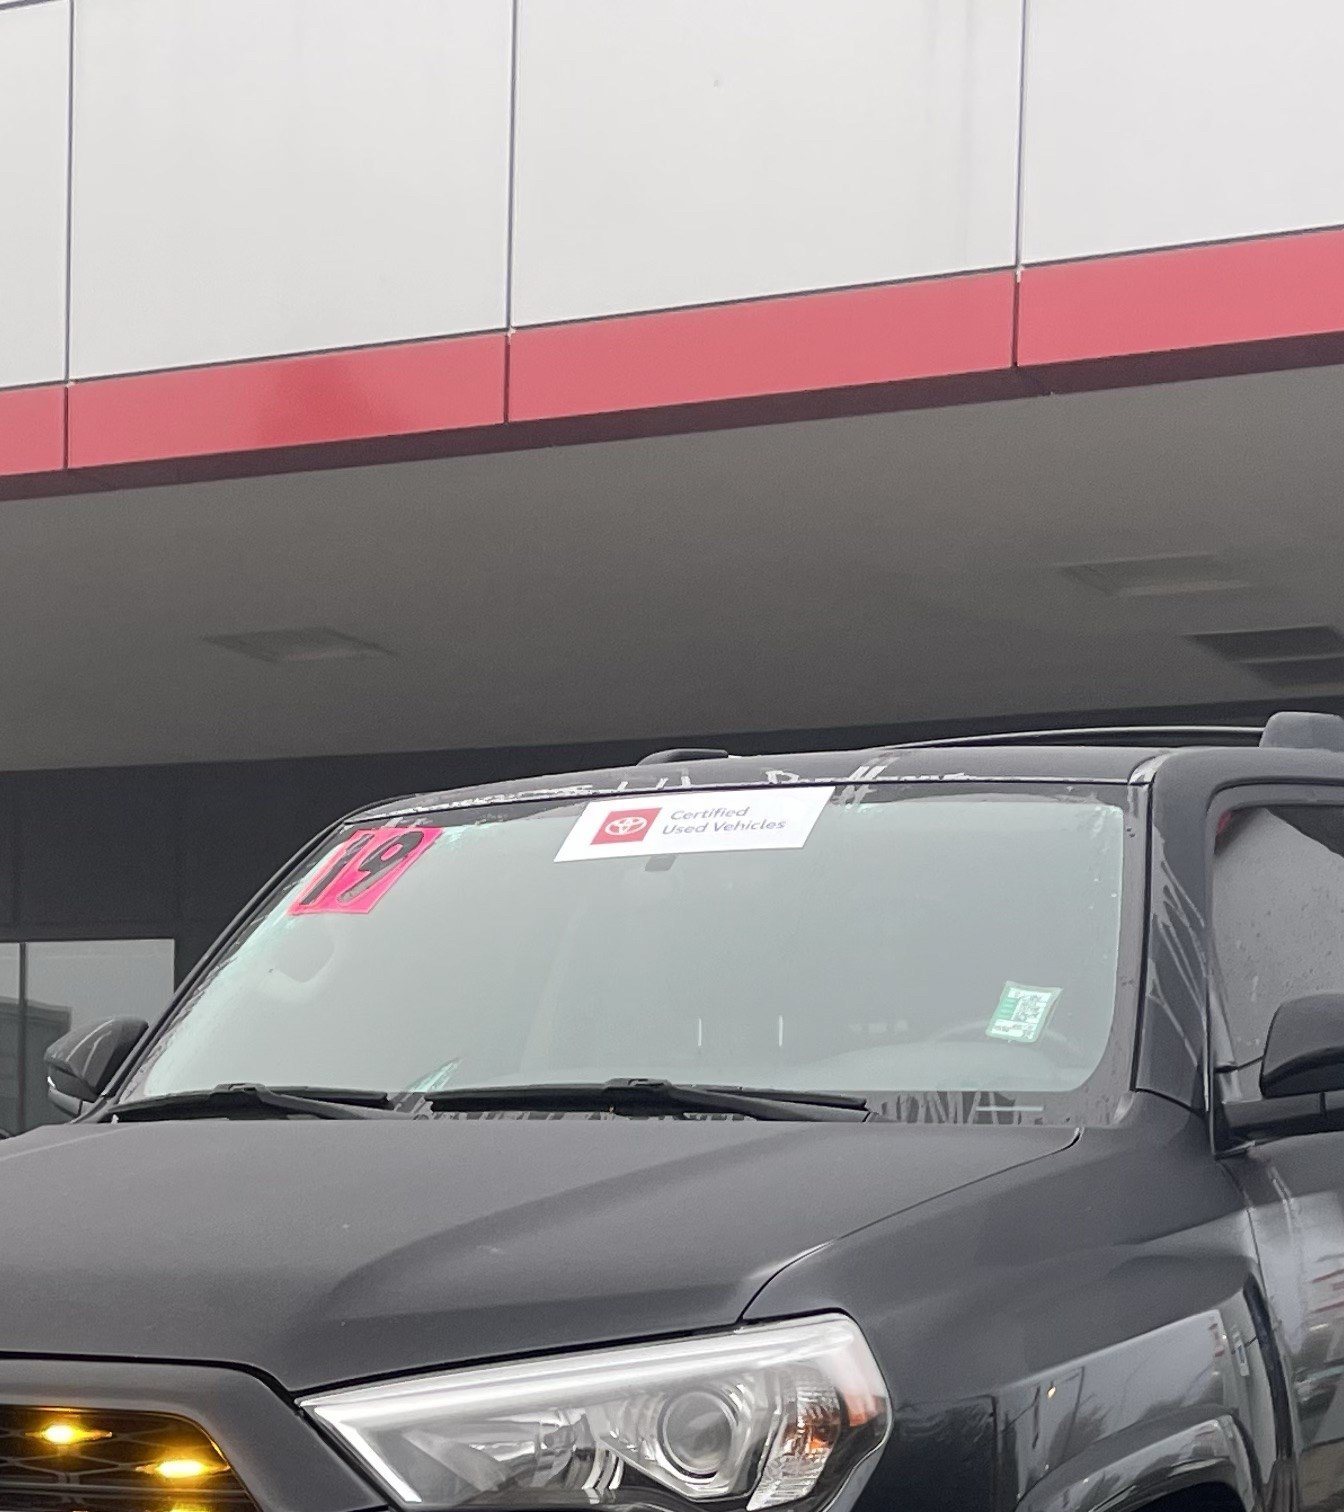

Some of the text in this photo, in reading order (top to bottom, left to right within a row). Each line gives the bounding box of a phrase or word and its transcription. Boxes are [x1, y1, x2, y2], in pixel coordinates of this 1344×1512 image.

[670, 806, 750, 821] Certified
[662, 818, 787, 836] Used Vehicles
[299, 832, 424, 905] 19
